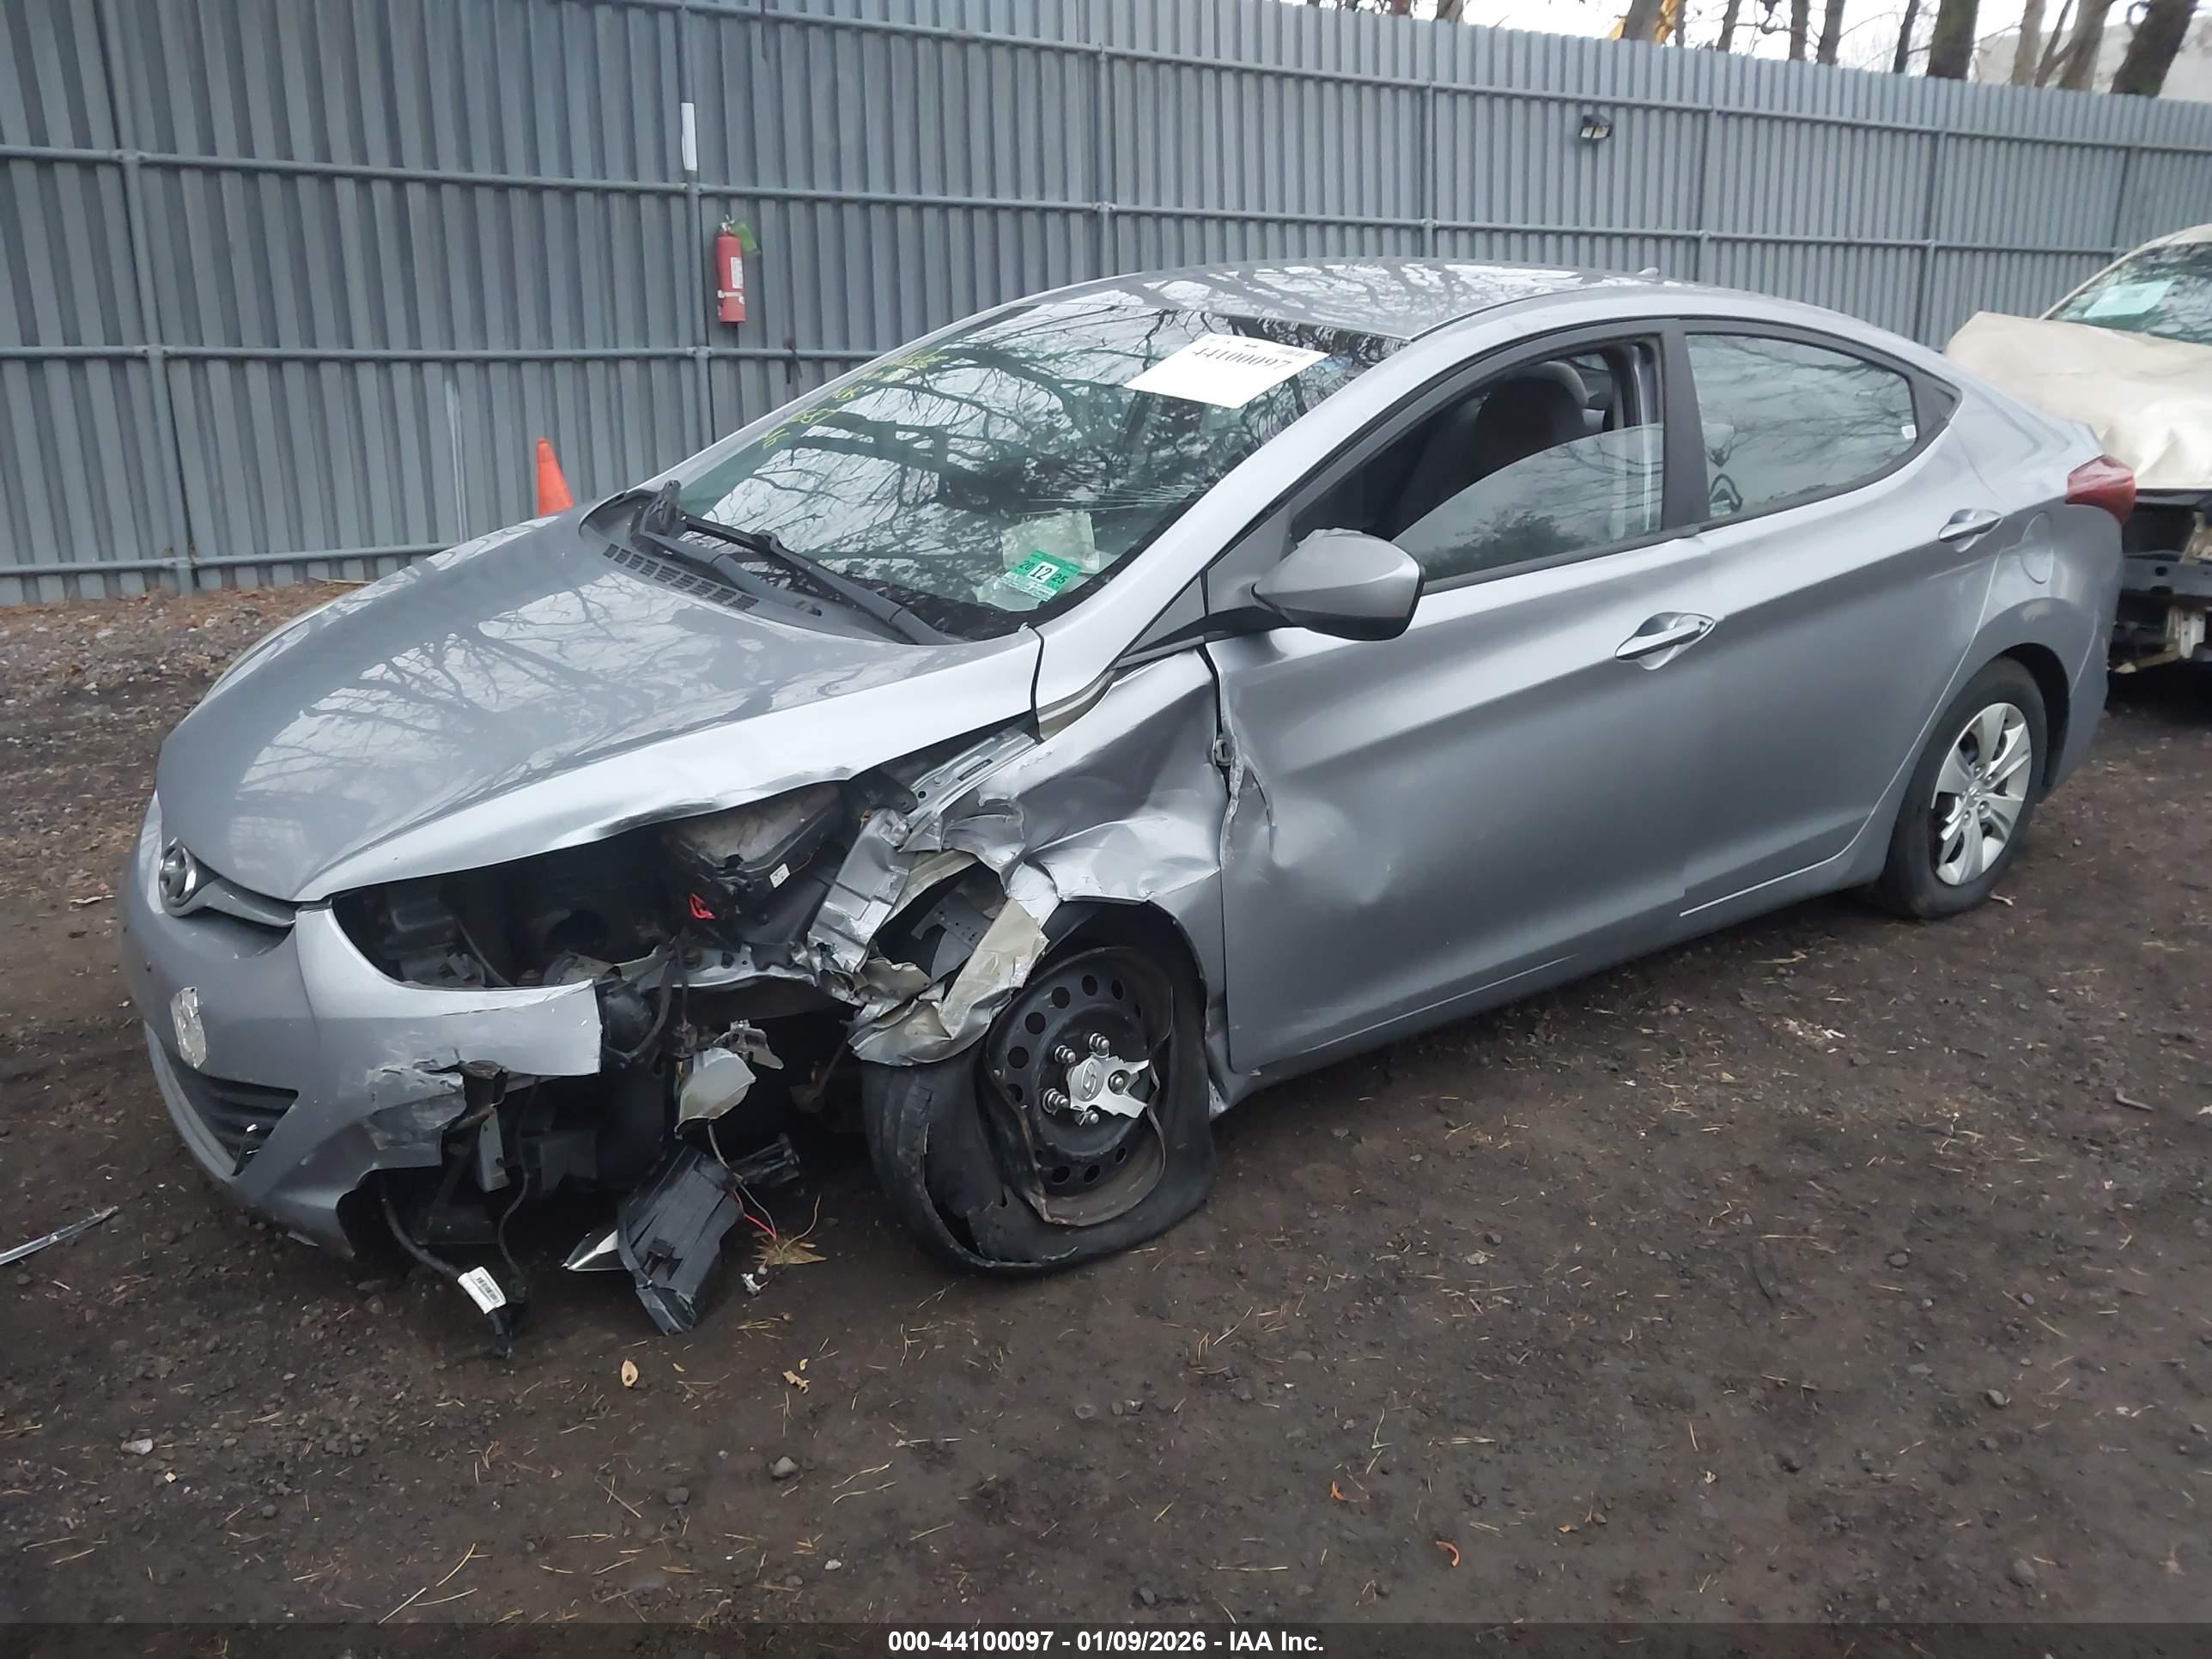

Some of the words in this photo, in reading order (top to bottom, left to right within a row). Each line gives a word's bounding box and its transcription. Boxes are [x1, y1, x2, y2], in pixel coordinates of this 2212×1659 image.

[1192, 347, 1292, 370] 44100097
[1019, 560, 1035, 571] 20
[1030, 565, 1054, 580] 12
[1052, 573, 1068, 585] 25
